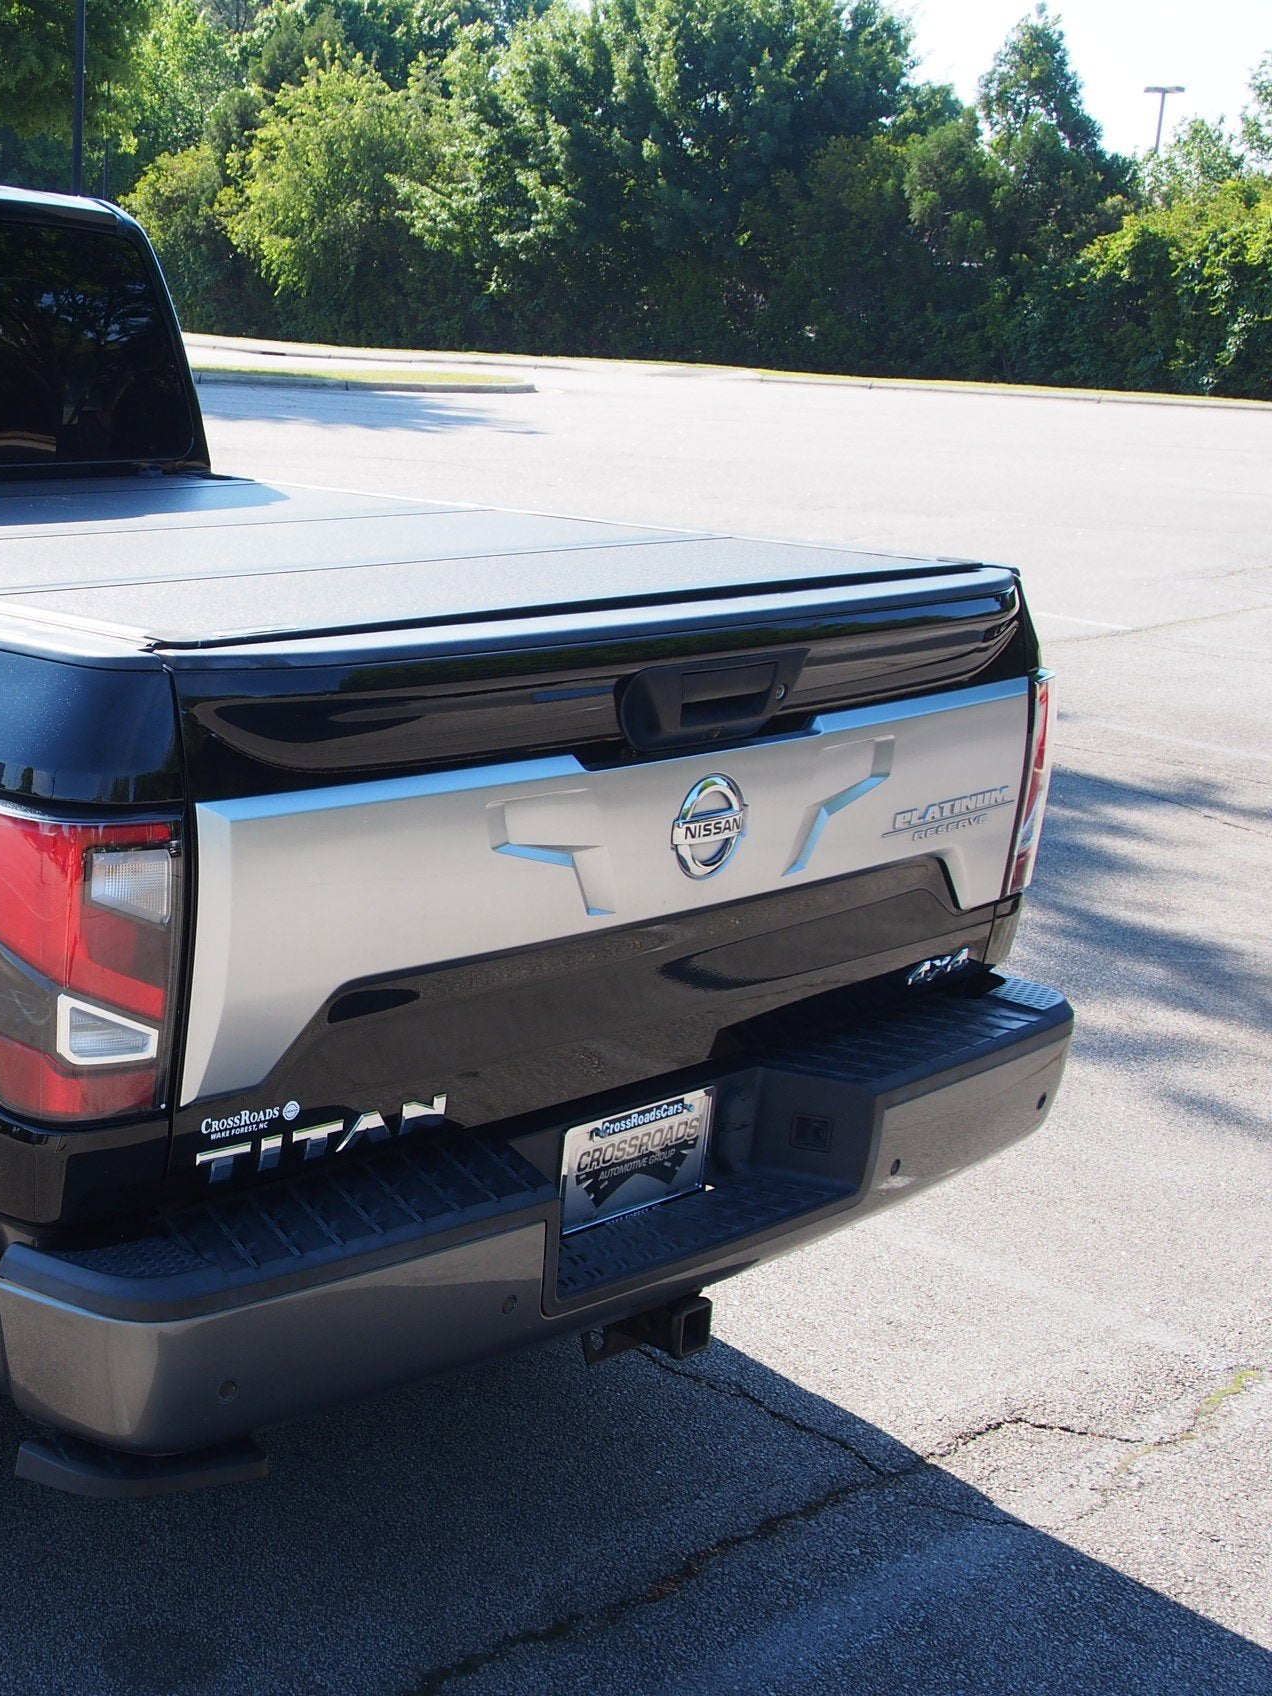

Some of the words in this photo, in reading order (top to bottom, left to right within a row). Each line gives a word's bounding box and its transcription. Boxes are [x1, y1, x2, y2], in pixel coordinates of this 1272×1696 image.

[893, 785, 1010, 830] PLATINUM
[685, 816, 741, 839] NISSAN
[913, 813, 989, 841] RESERVE
[195, 1094, 447, 1184] TITAN
[210, 1132, 229, 1140] WAKE
[231, 1124, 258, 1136] FOREST,
[576, 1115, 700, 1173] CROSSROADS
[599, 1157, 648, 1180] AUTOMOTIVE
[649, 1149, 676, 1165] GROUP
